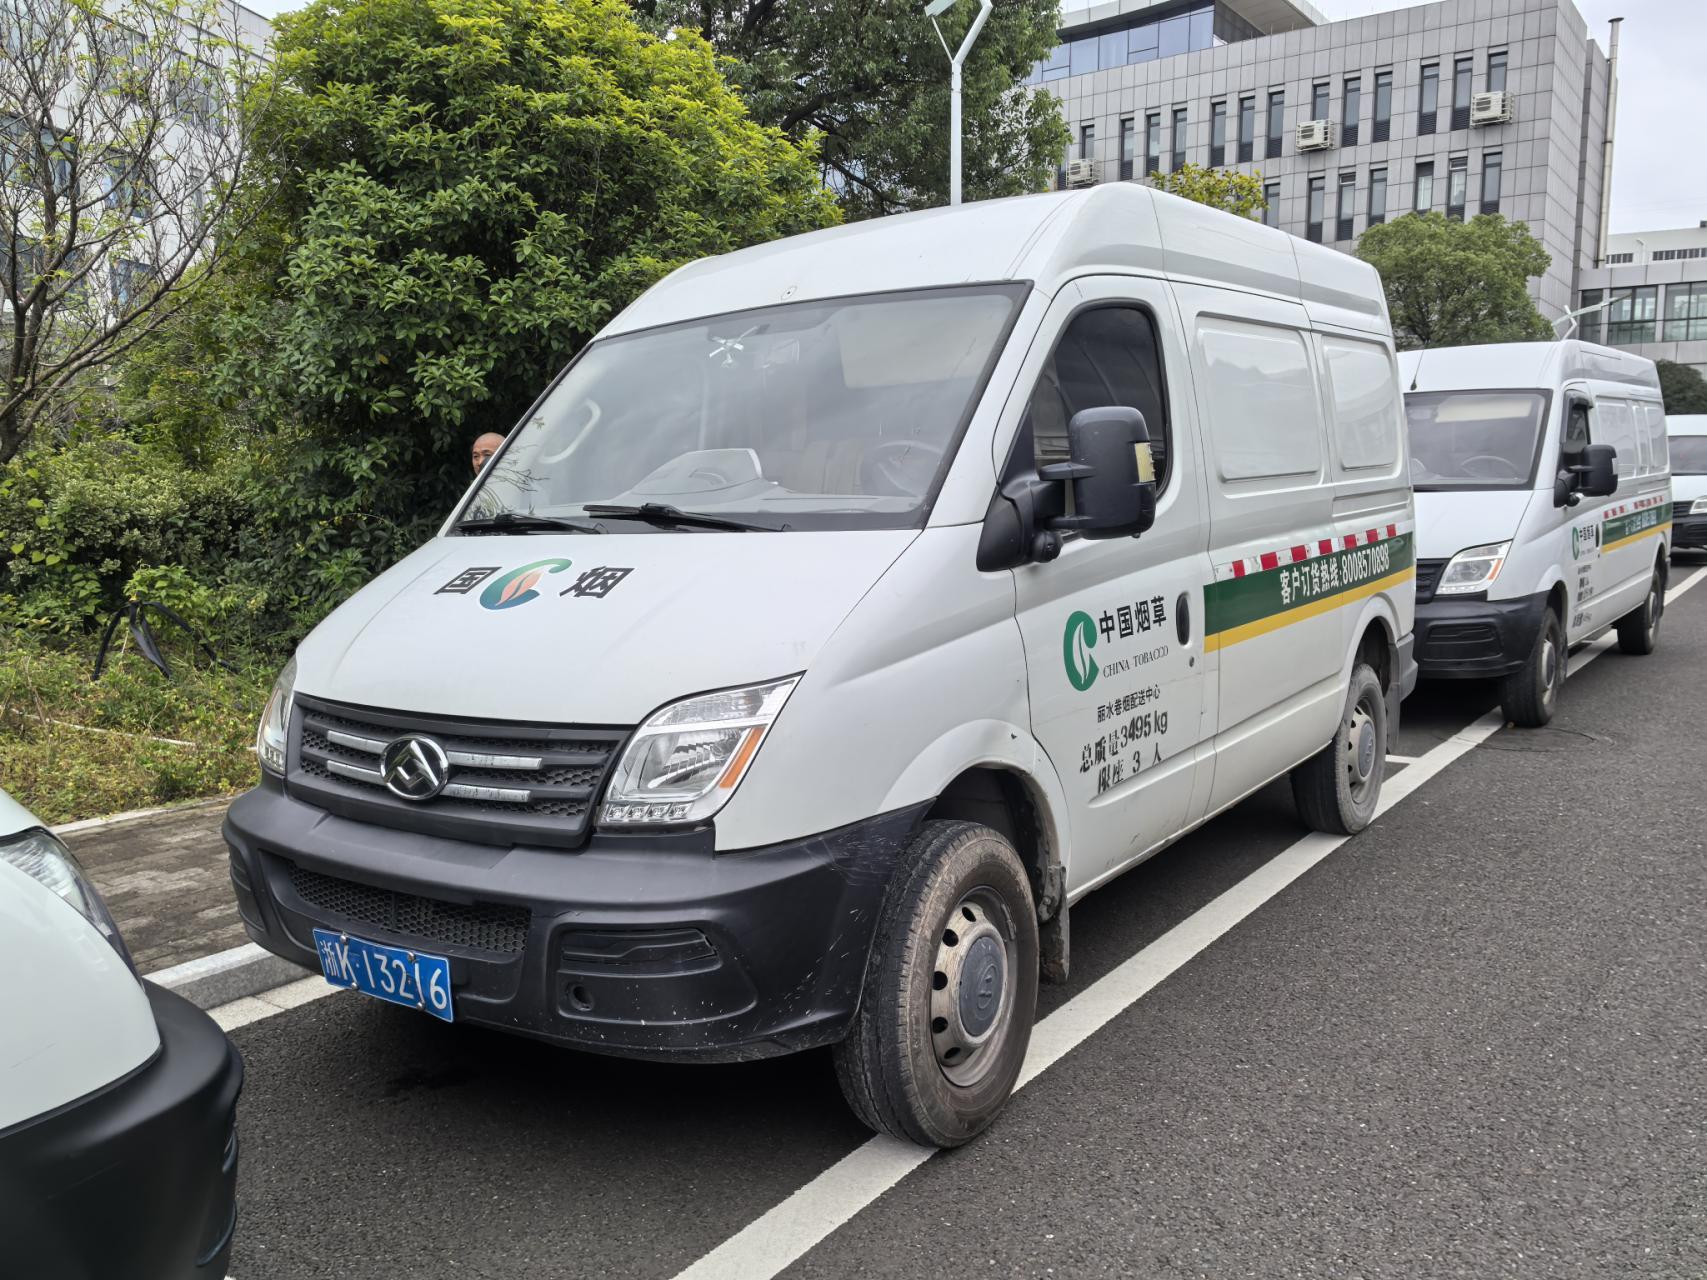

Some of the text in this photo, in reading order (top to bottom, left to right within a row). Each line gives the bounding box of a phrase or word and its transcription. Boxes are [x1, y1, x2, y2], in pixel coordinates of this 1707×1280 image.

[433, 566, 635, 599] 国 烟
[1099, 595, 1167, 644] 中国烟草
[1103, 645, 1169, 679] CHINA TOBACCO
[1097, 684, 1161, 723] 丽水卷烟配送中心
